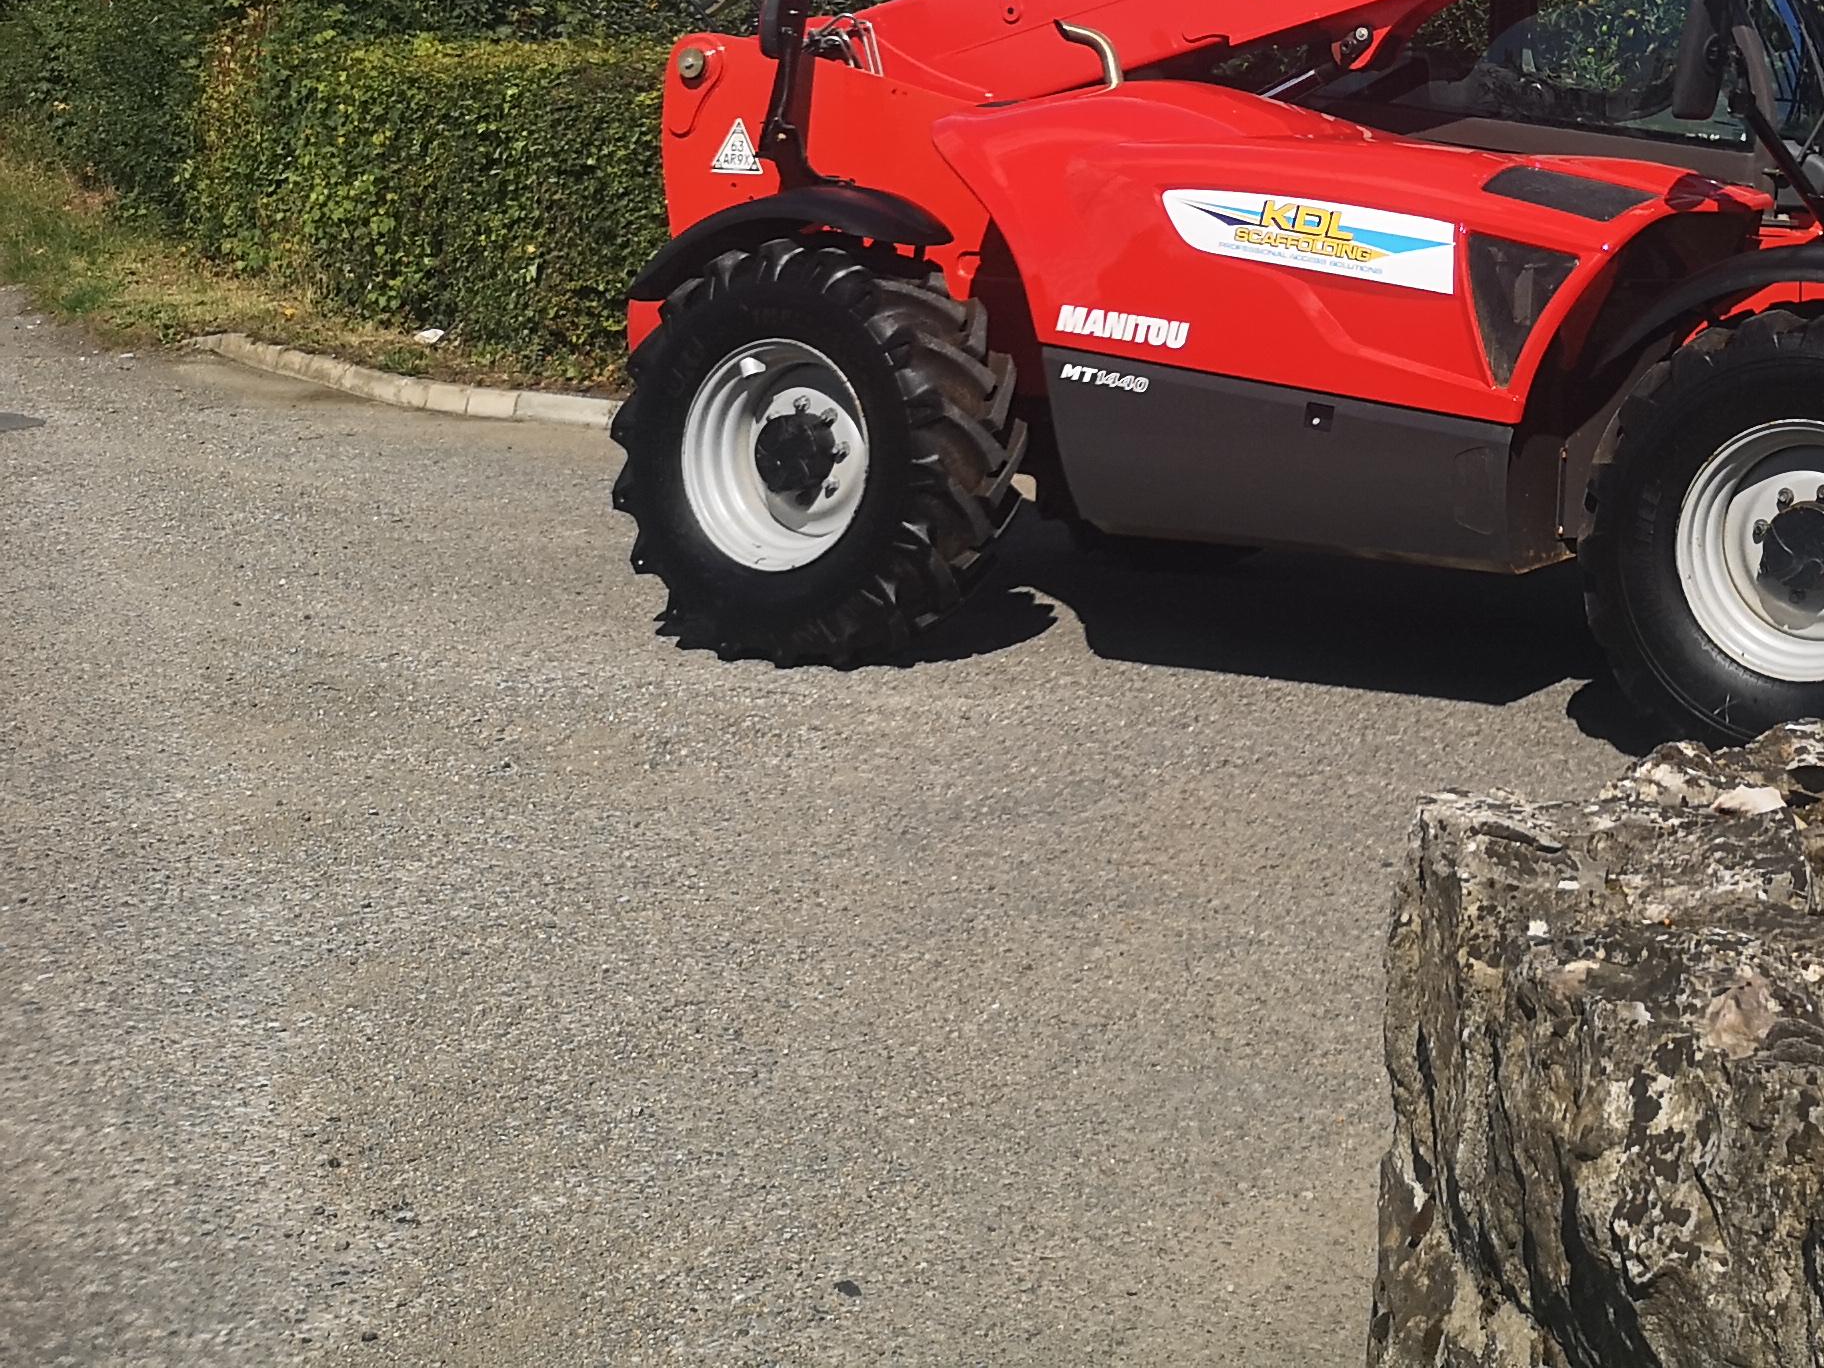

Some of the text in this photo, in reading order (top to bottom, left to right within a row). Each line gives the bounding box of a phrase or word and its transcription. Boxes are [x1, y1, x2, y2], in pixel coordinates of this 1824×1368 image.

[1259, 199, 1354, 242] KDL
[1234, 226, 1374, 263] SCAFFOLDING
[1055, 304, 1190, 349] MANITOU
[1060, 363, 1150, 393] MT1440
